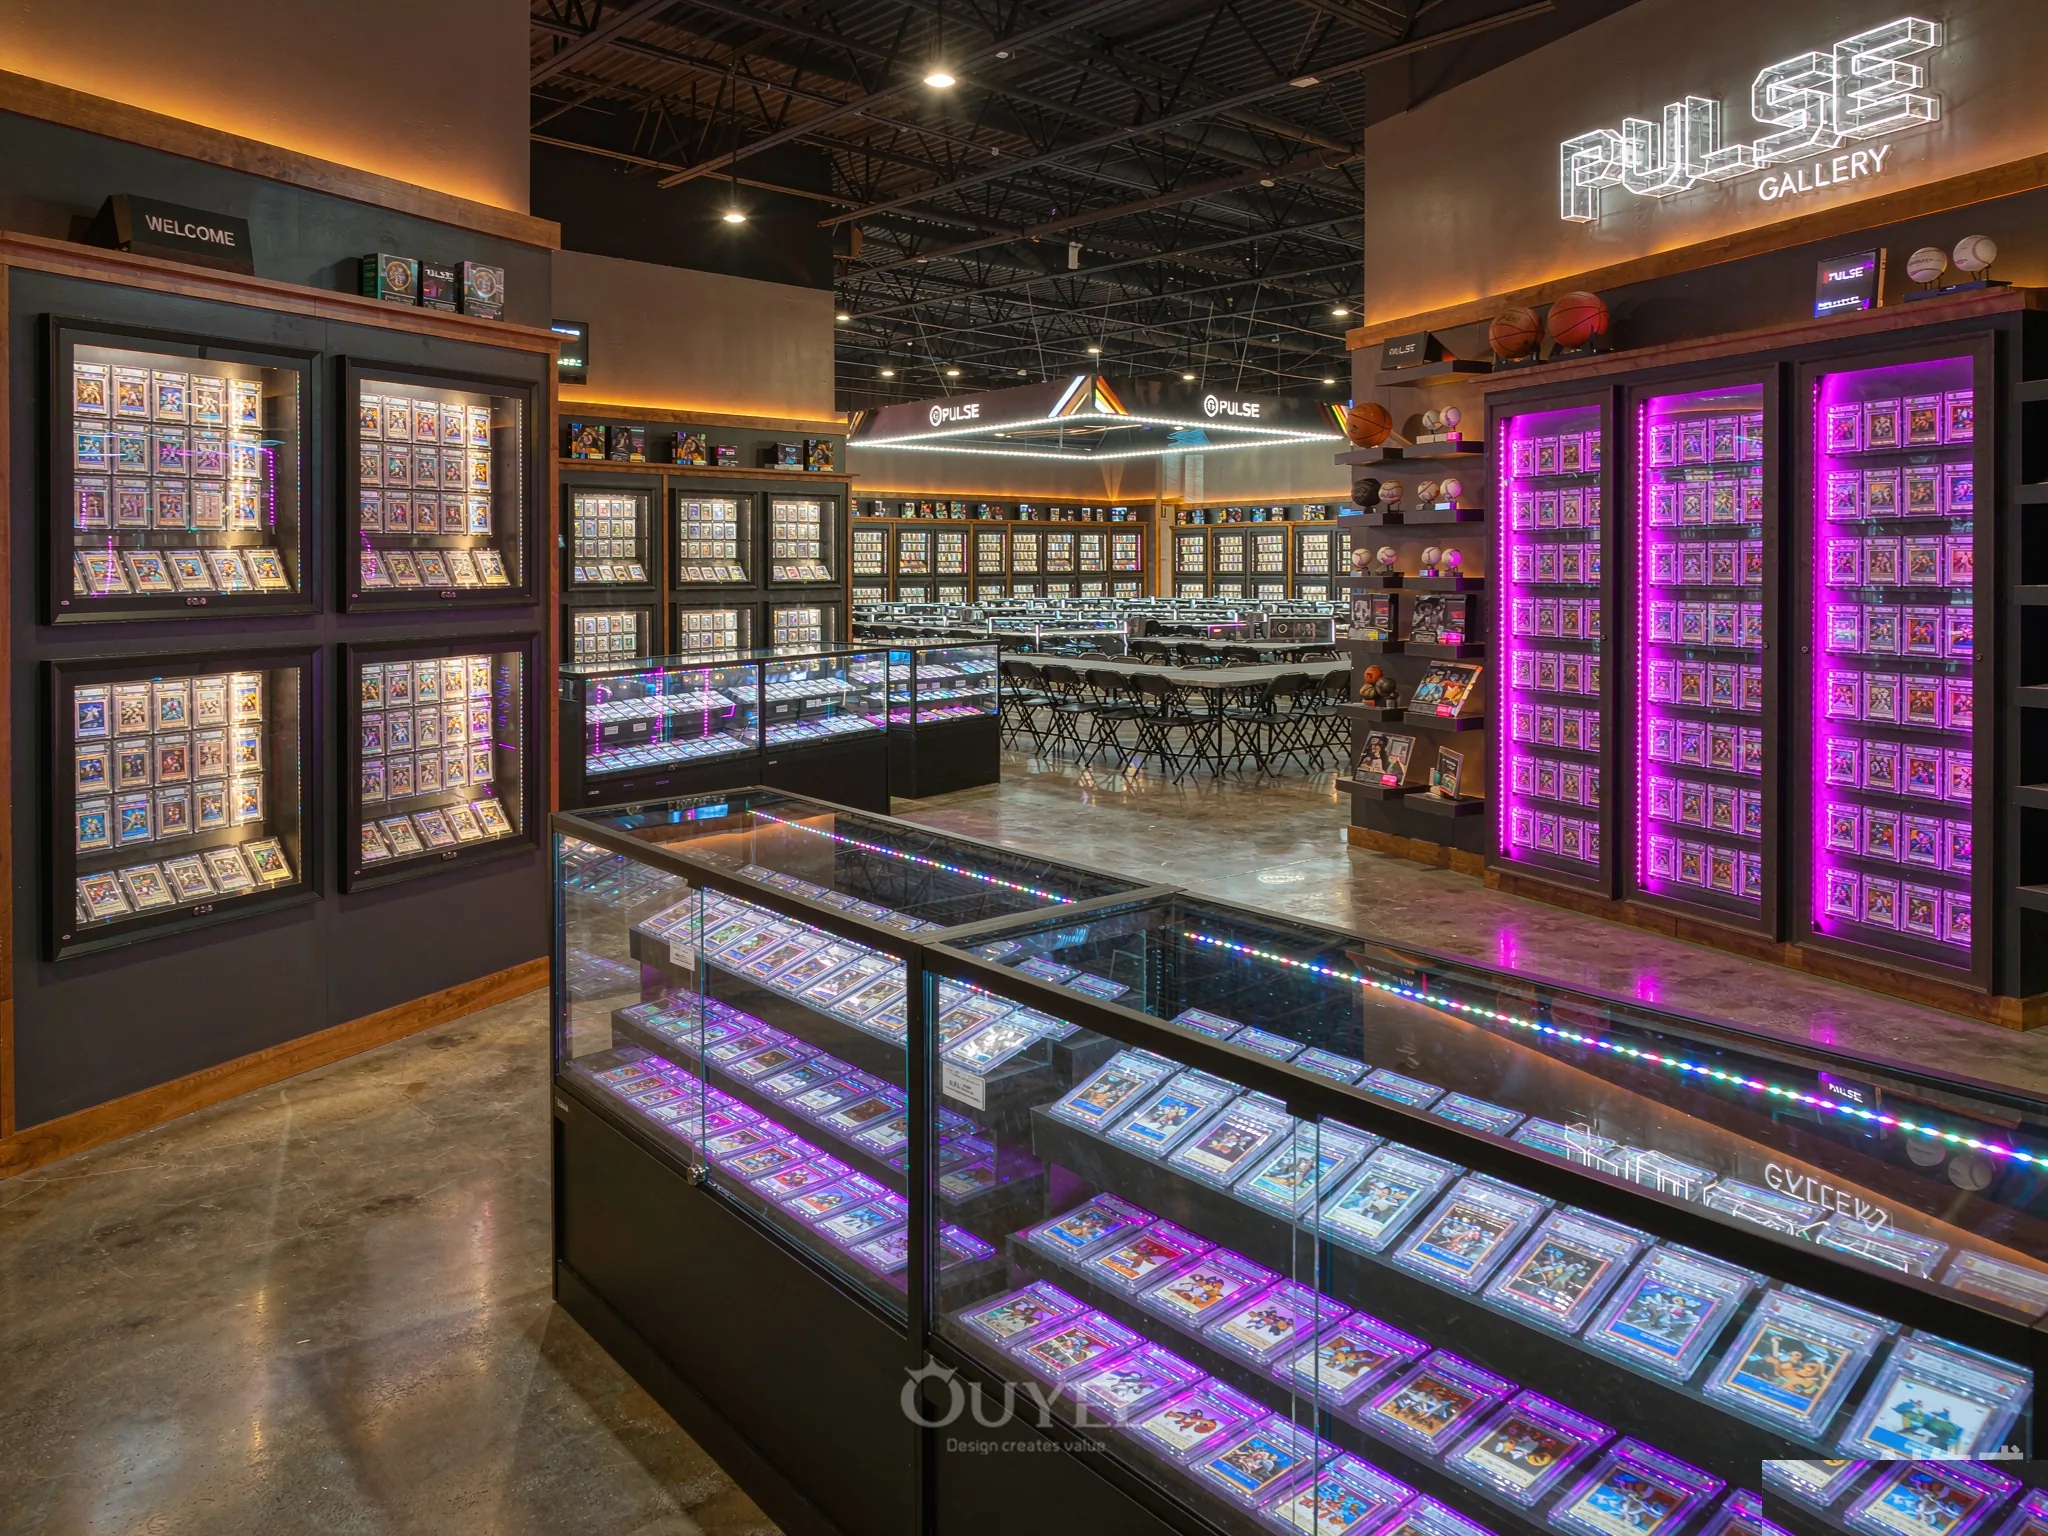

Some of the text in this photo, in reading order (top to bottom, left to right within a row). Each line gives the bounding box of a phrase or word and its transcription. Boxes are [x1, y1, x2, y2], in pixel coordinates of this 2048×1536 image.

[1560, 16, 1942, 224] PULSE
[1758, 144, 1890, 201] GALLERY
[144, 214, 236, 247] WELCOME
[942, 403, 980, 422] PULSE
[1219, 400, 1260, 418] PULSE
